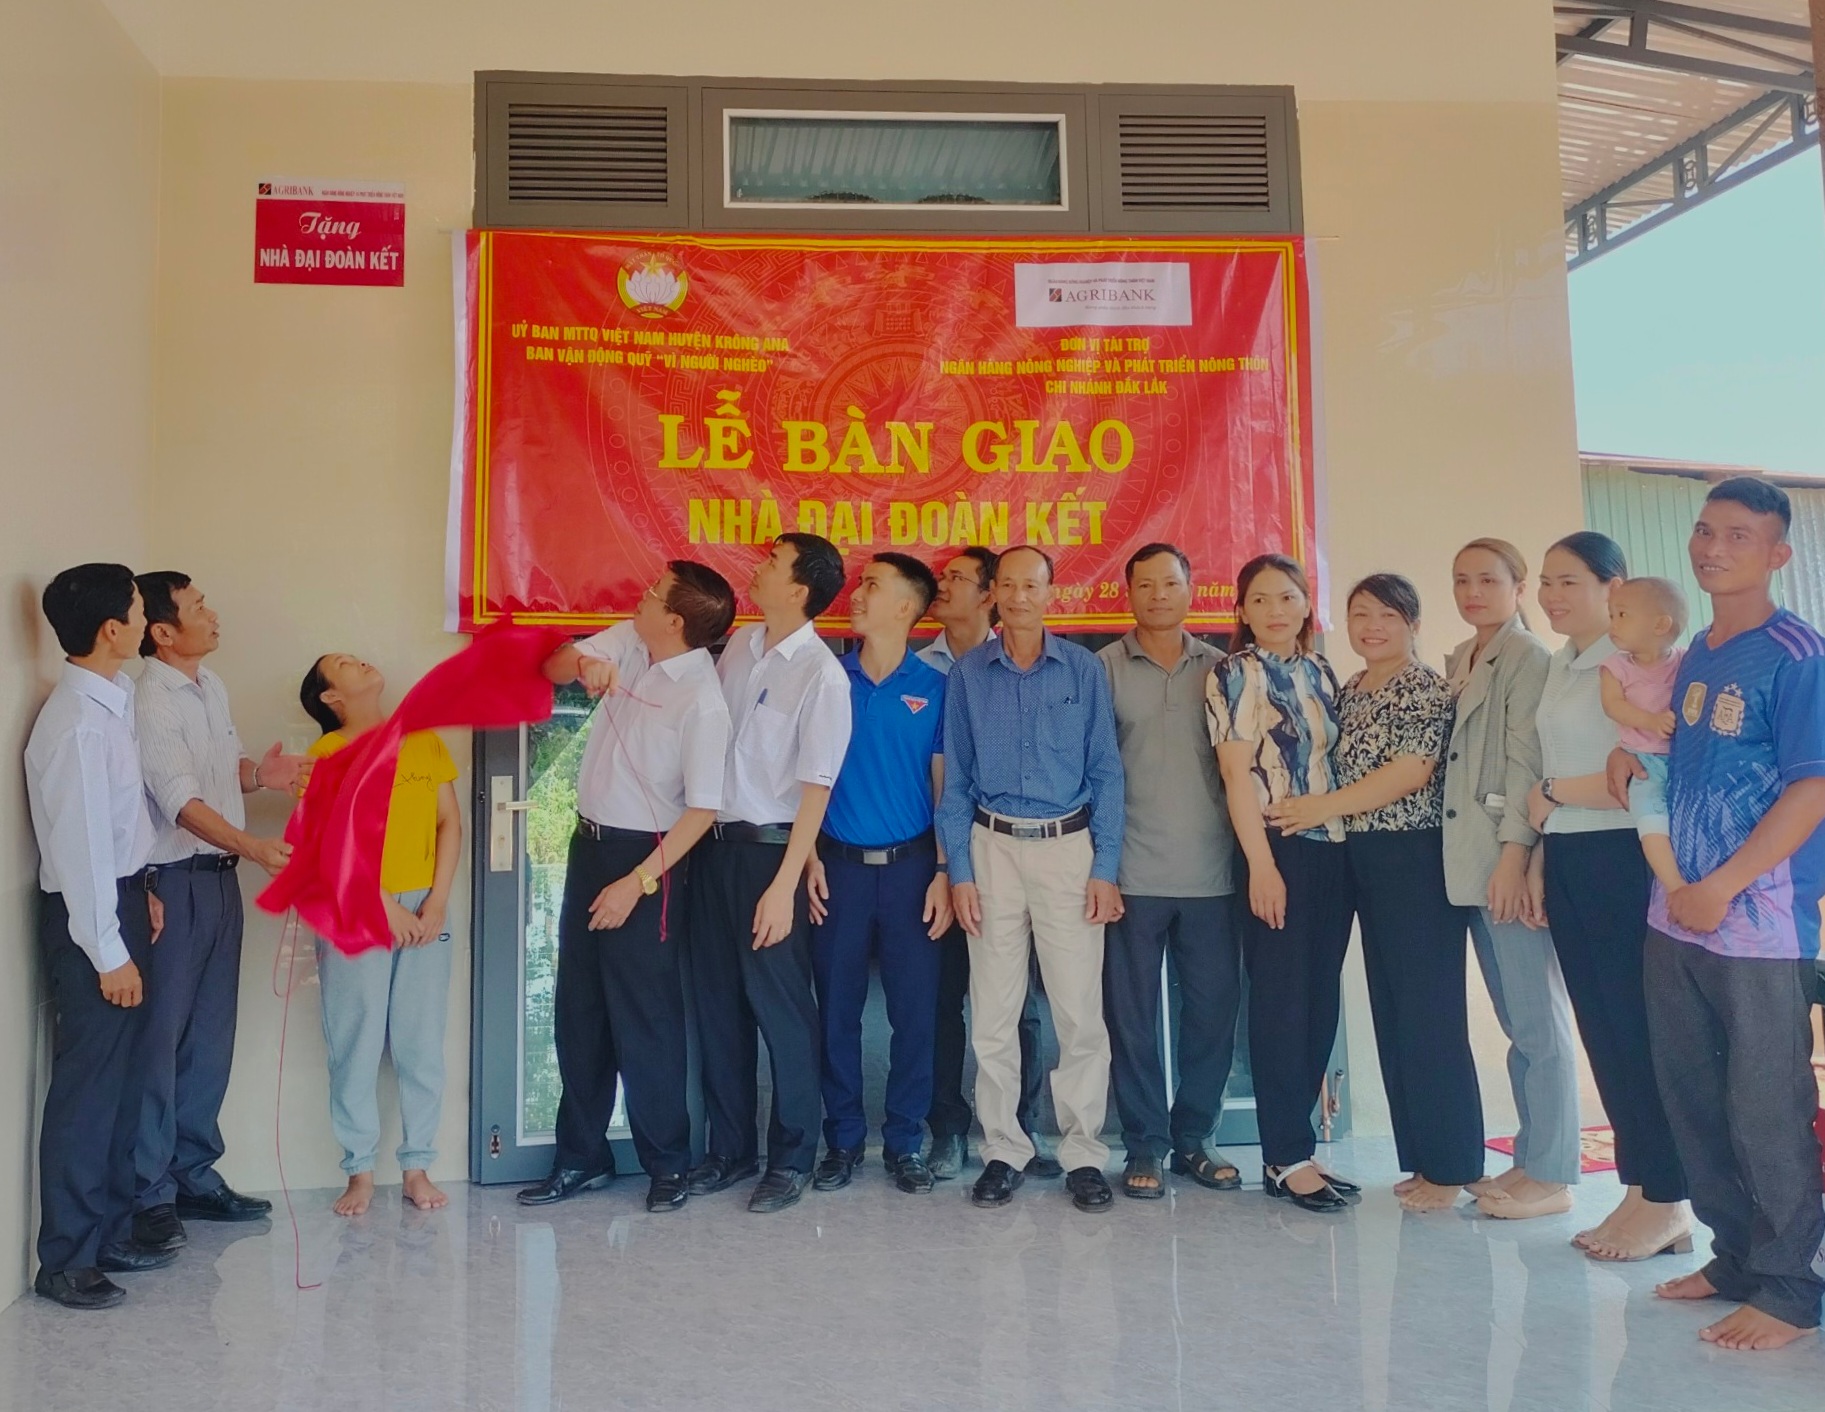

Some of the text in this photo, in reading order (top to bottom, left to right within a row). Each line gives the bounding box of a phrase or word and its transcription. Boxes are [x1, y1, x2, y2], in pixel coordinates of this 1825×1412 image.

[273, 185, 314, 196] AGRIBANK
[299, 211, 362, 240] Tặng
[259, 244, 399, 271] NHÀ ĐẠI ĐOÀN KẾT
[1065, 288, 1156, 302] AGRIBANK
[511, 319, 789, 351] UỶ BAN MTTQ VIỆT NAM HUYỆN KRÔNG ANA
[1060, 336, 1150, 354] ĐƠN VỊ TÀI TRỢ
[526, 345, 554, 361] BAN
[557, 346, 584, 366] VẬN
[587, 346, 624, 367] ĐỘNG
[627, 350, 652, 367] QUỸ
[680, 353, 719, 370] NGƯỜI
[940, 354, 1269, 376] NGÂN HÀNG NÔNG NGHIỆP VÀ PHÁT TRIỂN NÔNG THÔN
[1045, 379, 1066, 394] CHI
[1070, 378, 1112, 394] NHÁNH
[658, 389, 1135, 474] LỄ BÀN GIAO
[688, 488, 1107, 556] NHÀ ĐẠI ĐOÀN KẾT
[1099, 581, 1119, 598] 28
[1197, 581, 1236, 598] năm
